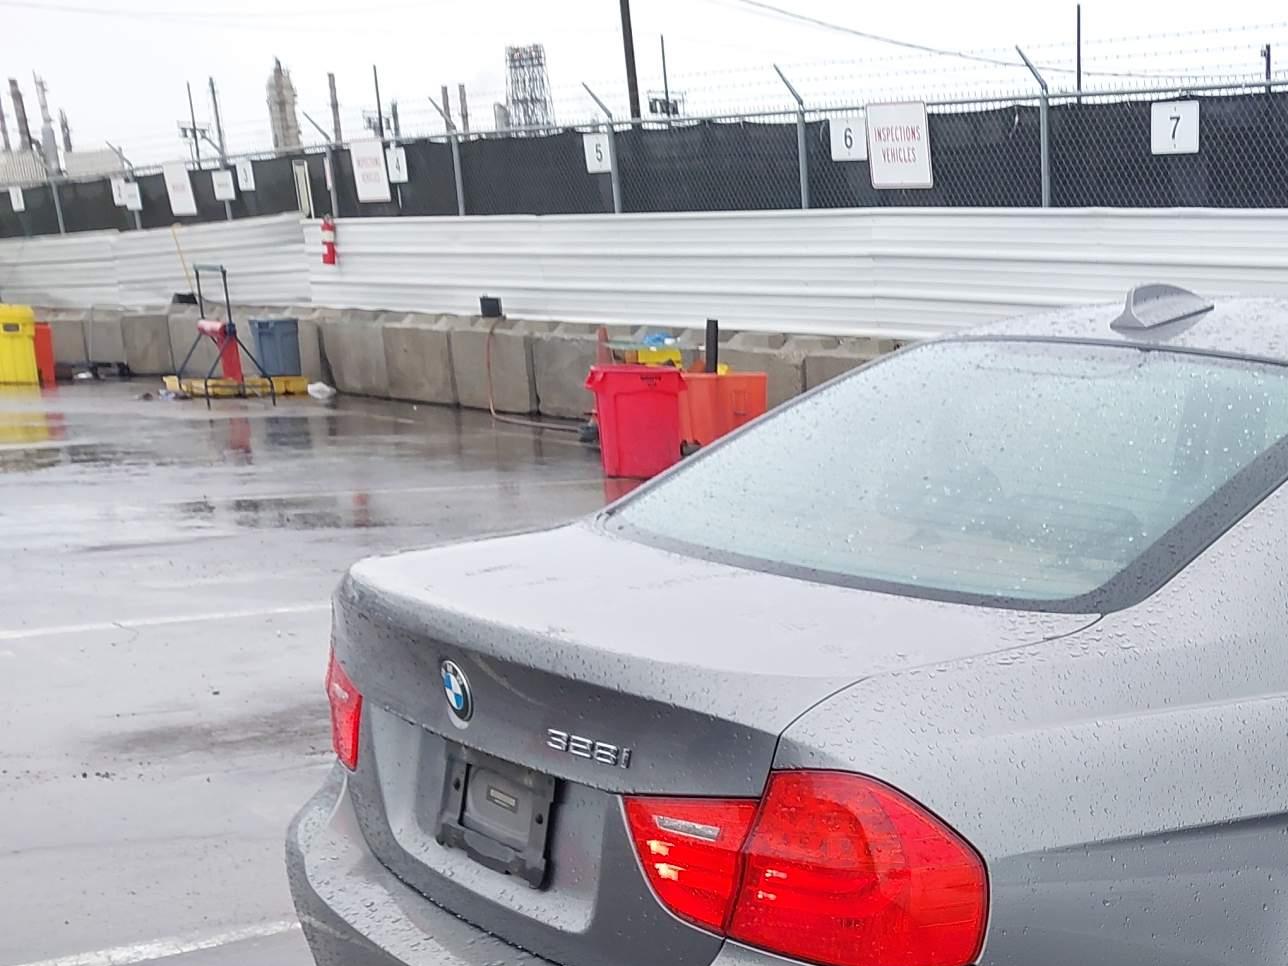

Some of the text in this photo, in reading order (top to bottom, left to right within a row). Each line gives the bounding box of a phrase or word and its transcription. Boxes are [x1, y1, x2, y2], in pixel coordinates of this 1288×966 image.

[873, 126, 921, 142] INSPECTIONS
[1169, 115, 1181, 140] 7
[844, 127, 853, 149] 6
[595, 143, 603, 162] 5
[881, 147, 917, 163] VEHICLES
[546, 728, 632, 769] 328i
